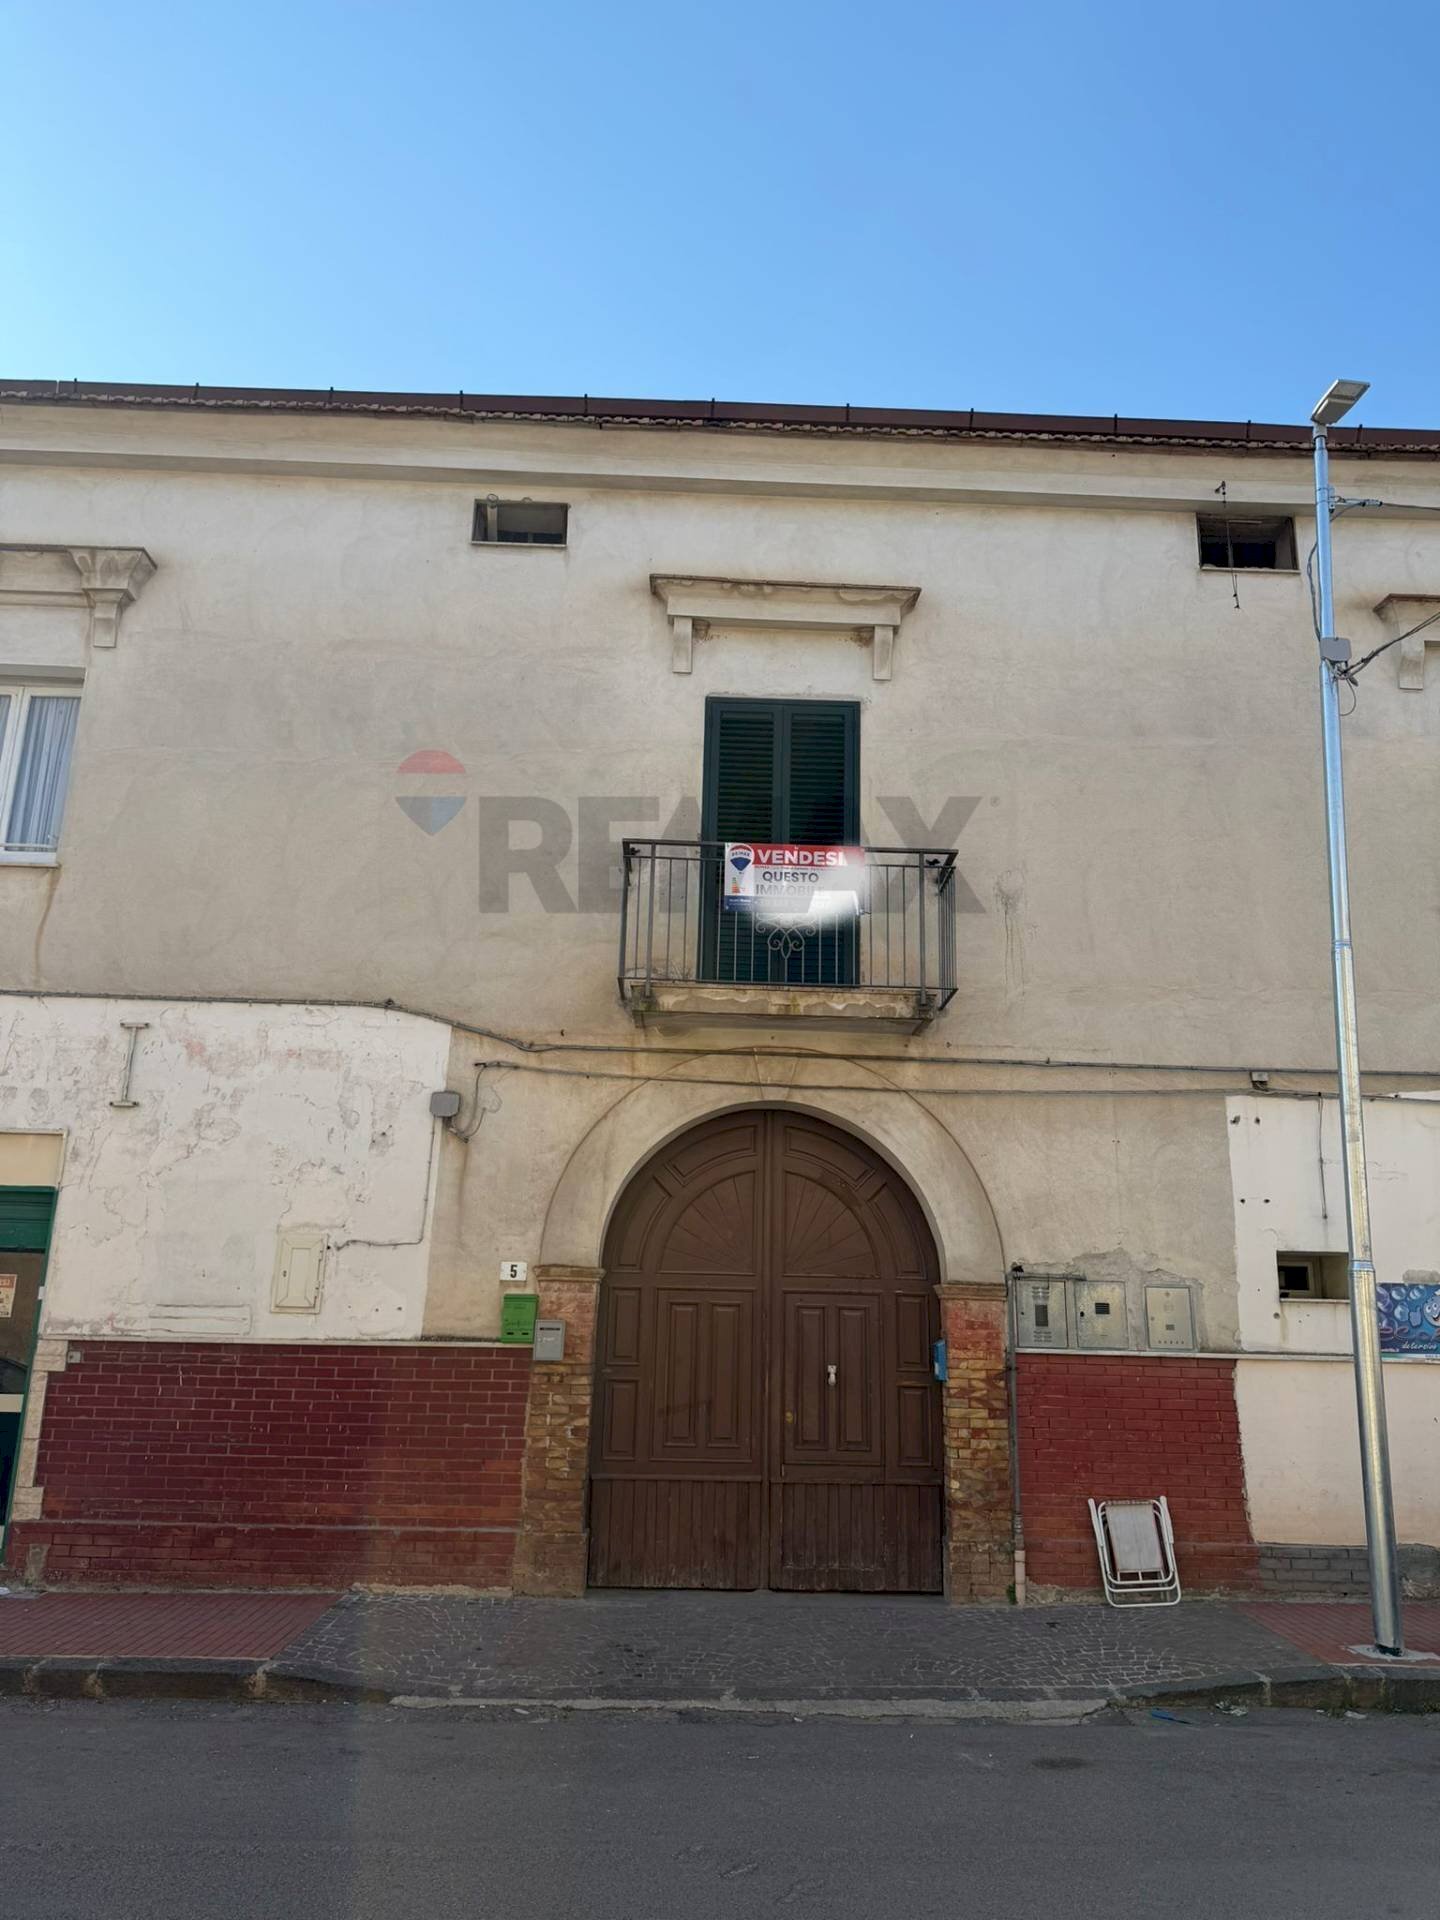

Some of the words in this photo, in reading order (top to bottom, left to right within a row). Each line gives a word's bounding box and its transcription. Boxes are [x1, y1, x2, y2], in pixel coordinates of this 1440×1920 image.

[757, 848, 848, 866] VENDESI
[762, 870, 819, 883] QUESTO
[510, 1264, 518, 1278] 5
